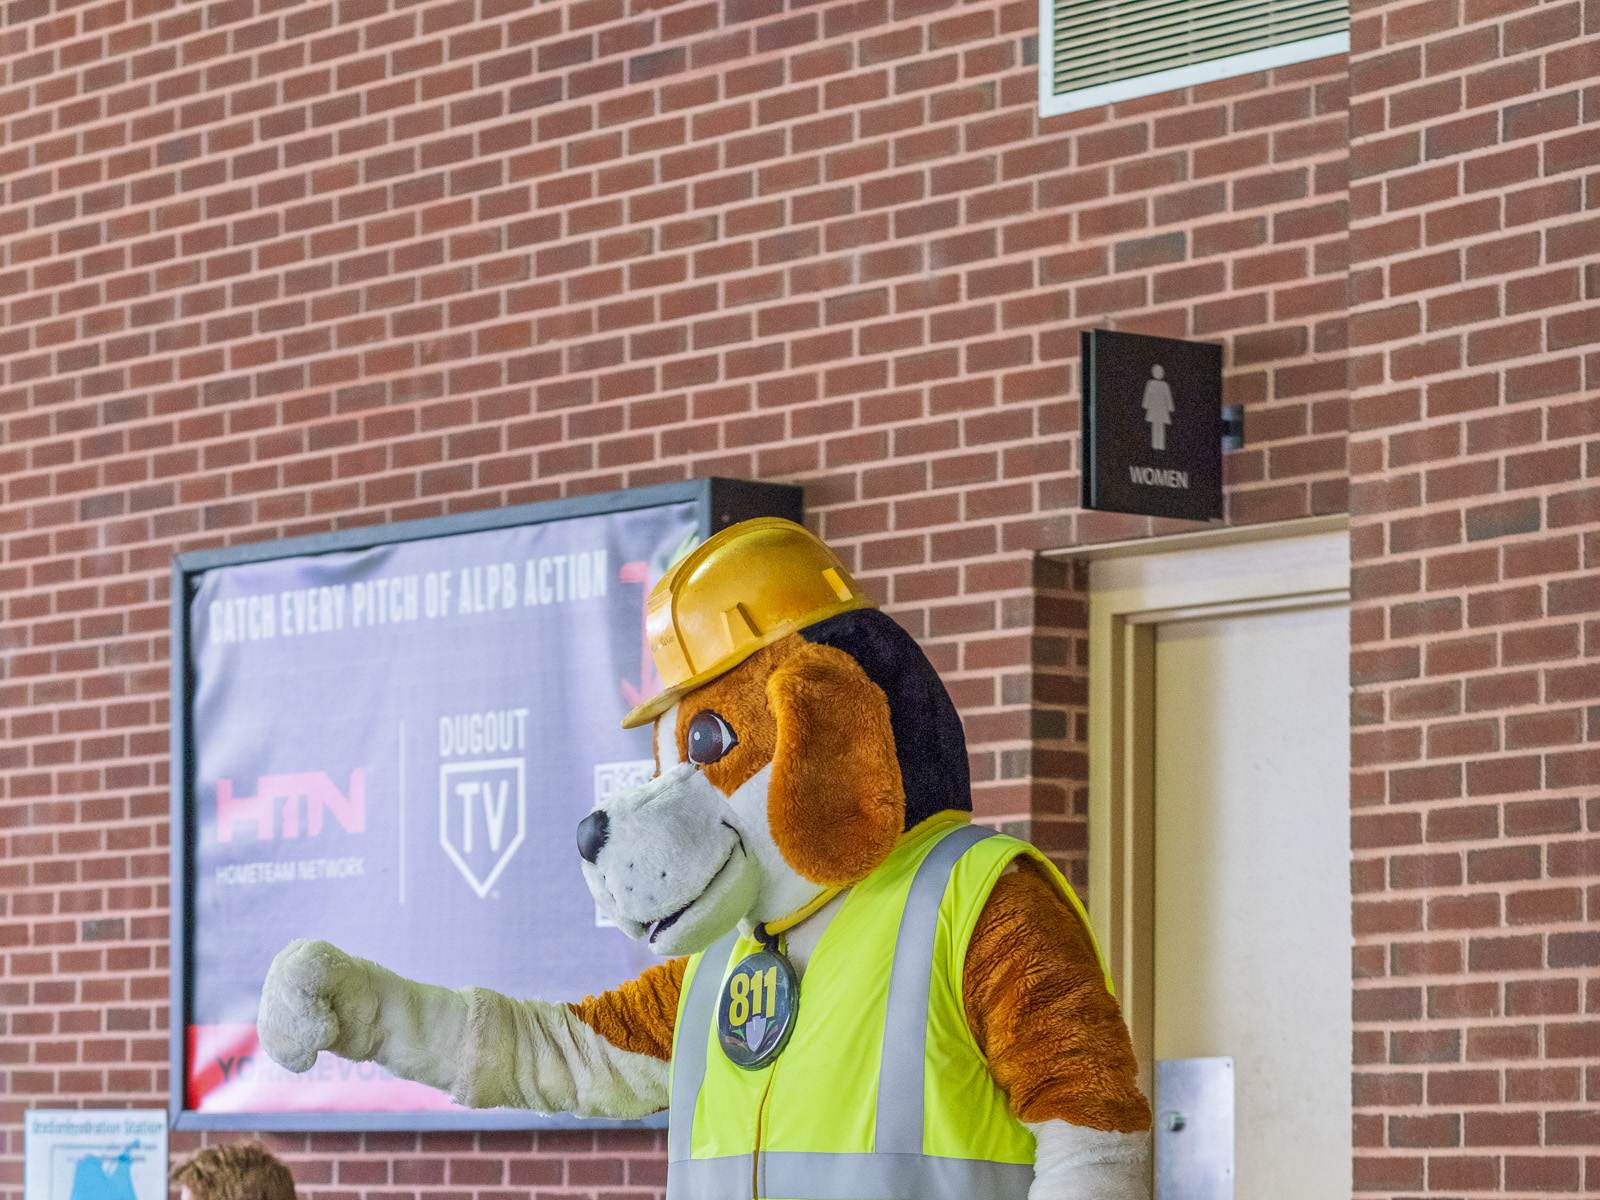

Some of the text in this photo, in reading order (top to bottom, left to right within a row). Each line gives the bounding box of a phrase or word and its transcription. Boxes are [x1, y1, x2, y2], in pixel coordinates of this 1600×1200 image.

[1129, 466, 1189, 488] WOMEN
[209, 550, 607, 644] CATCH EVERY PITCH OF ALPB ACTION
[440, 708, 529, 757] DUGOUT
[455, 780, 509, 853] TV
[729, 966, 777, 1026] 811
